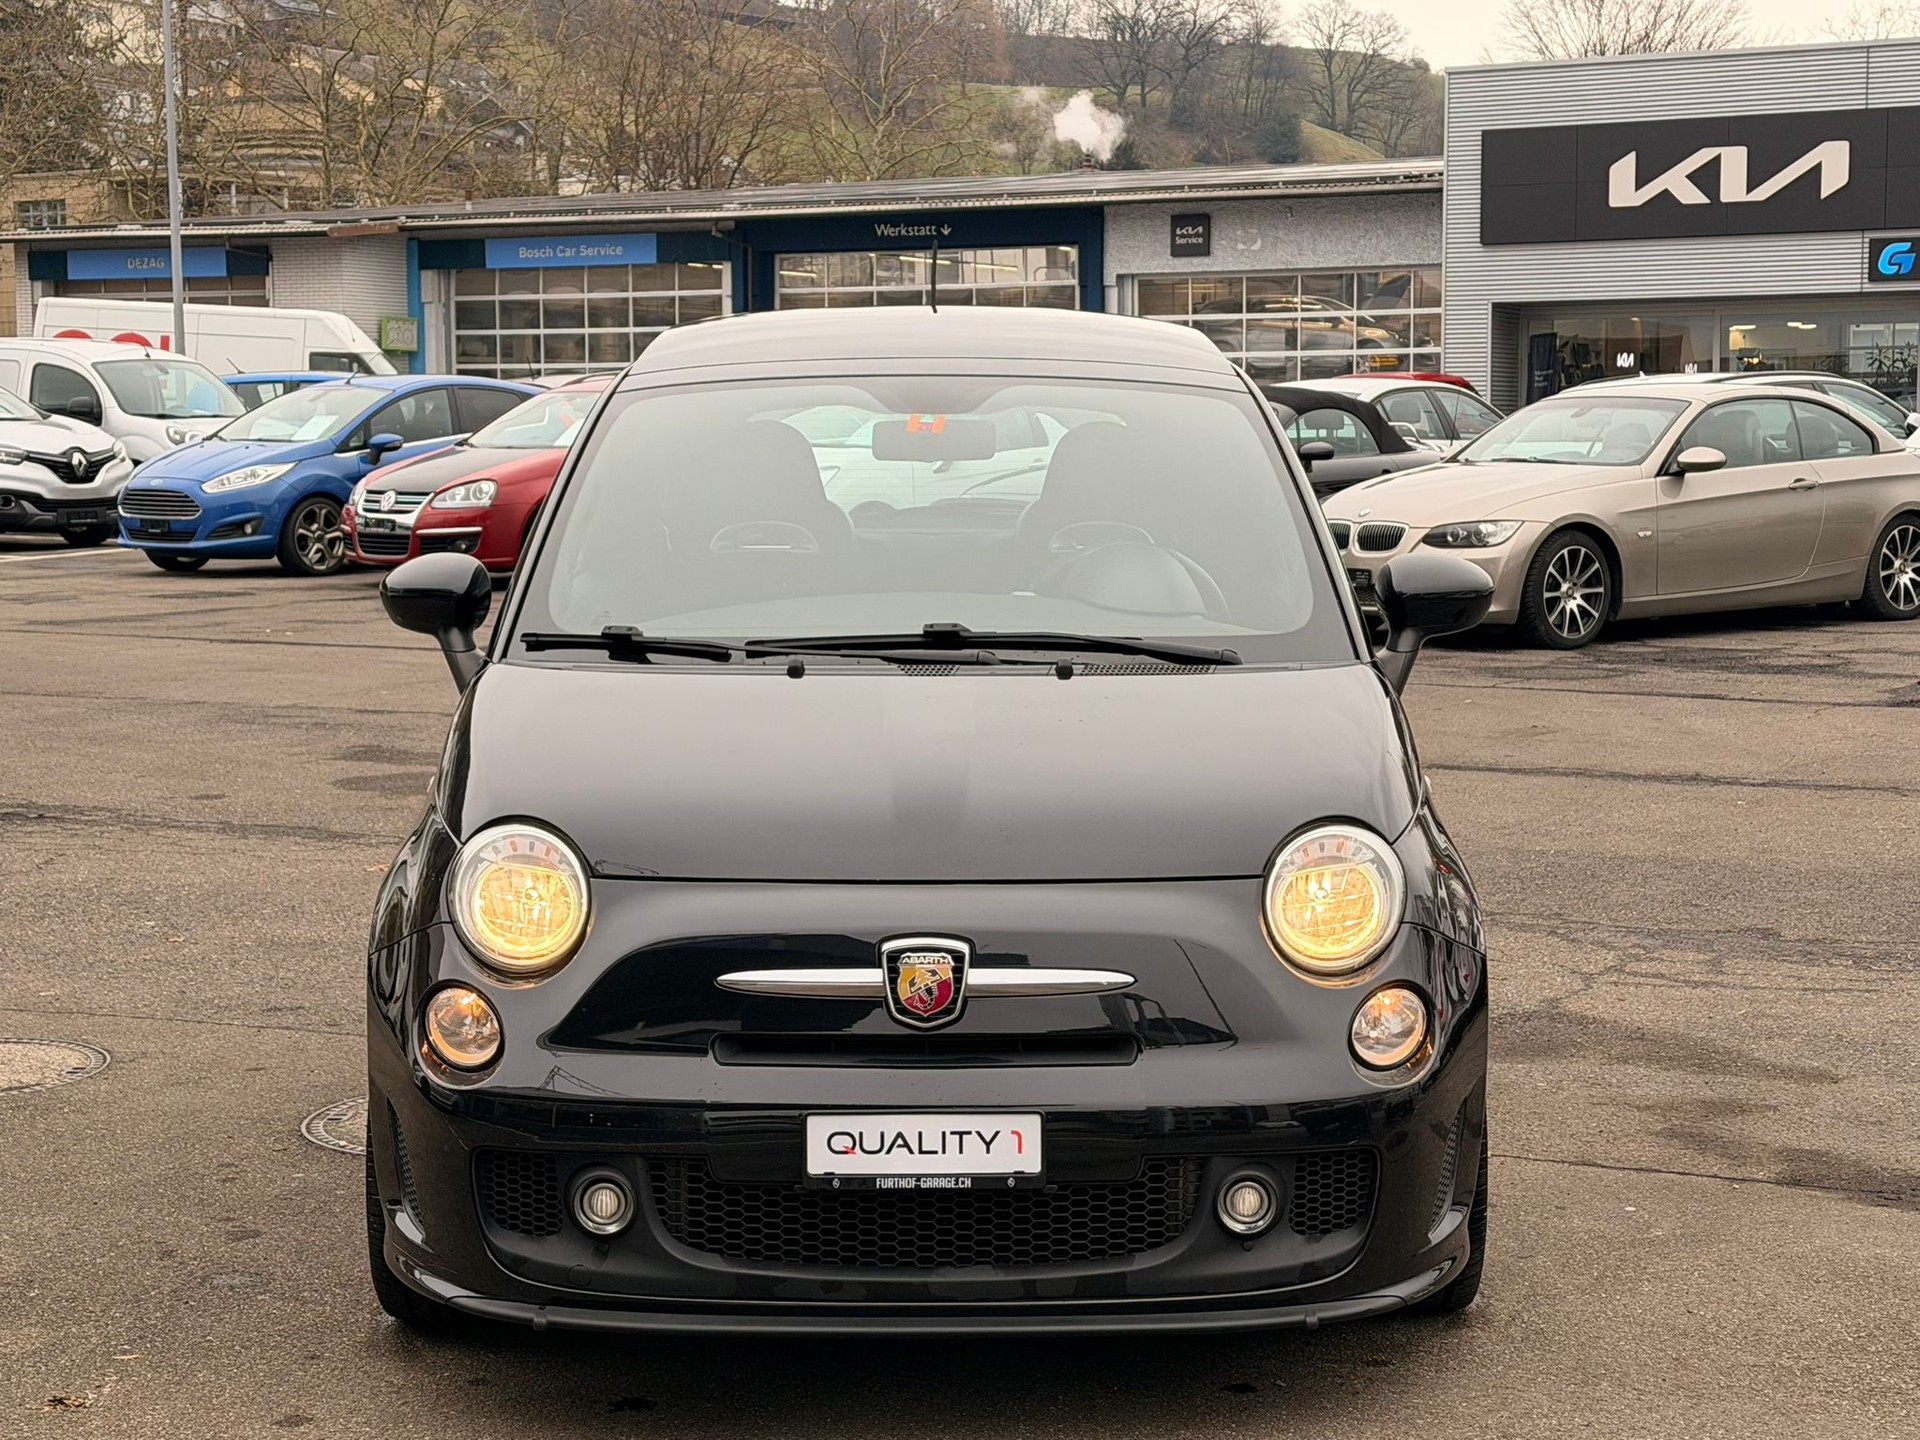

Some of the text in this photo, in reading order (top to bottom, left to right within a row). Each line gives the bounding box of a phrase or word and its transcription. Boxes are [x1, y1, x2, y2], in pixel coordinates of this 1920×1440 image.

[1608, 139, 1850, 208] KIA
[874, 223, 938, 237] Werkstatt
[1174, 236, 1203, 245] Service
[518, 243, 623, 258] Bosch Car Service
[127, 257, 165, 269] DEZAG
[901, 955, 949, 964] ABARTH
[826, 1129, 1023, 1155] QUALITY 1
[875, 1177, 972, 1189] FURTHOF-GARAGE.CH
